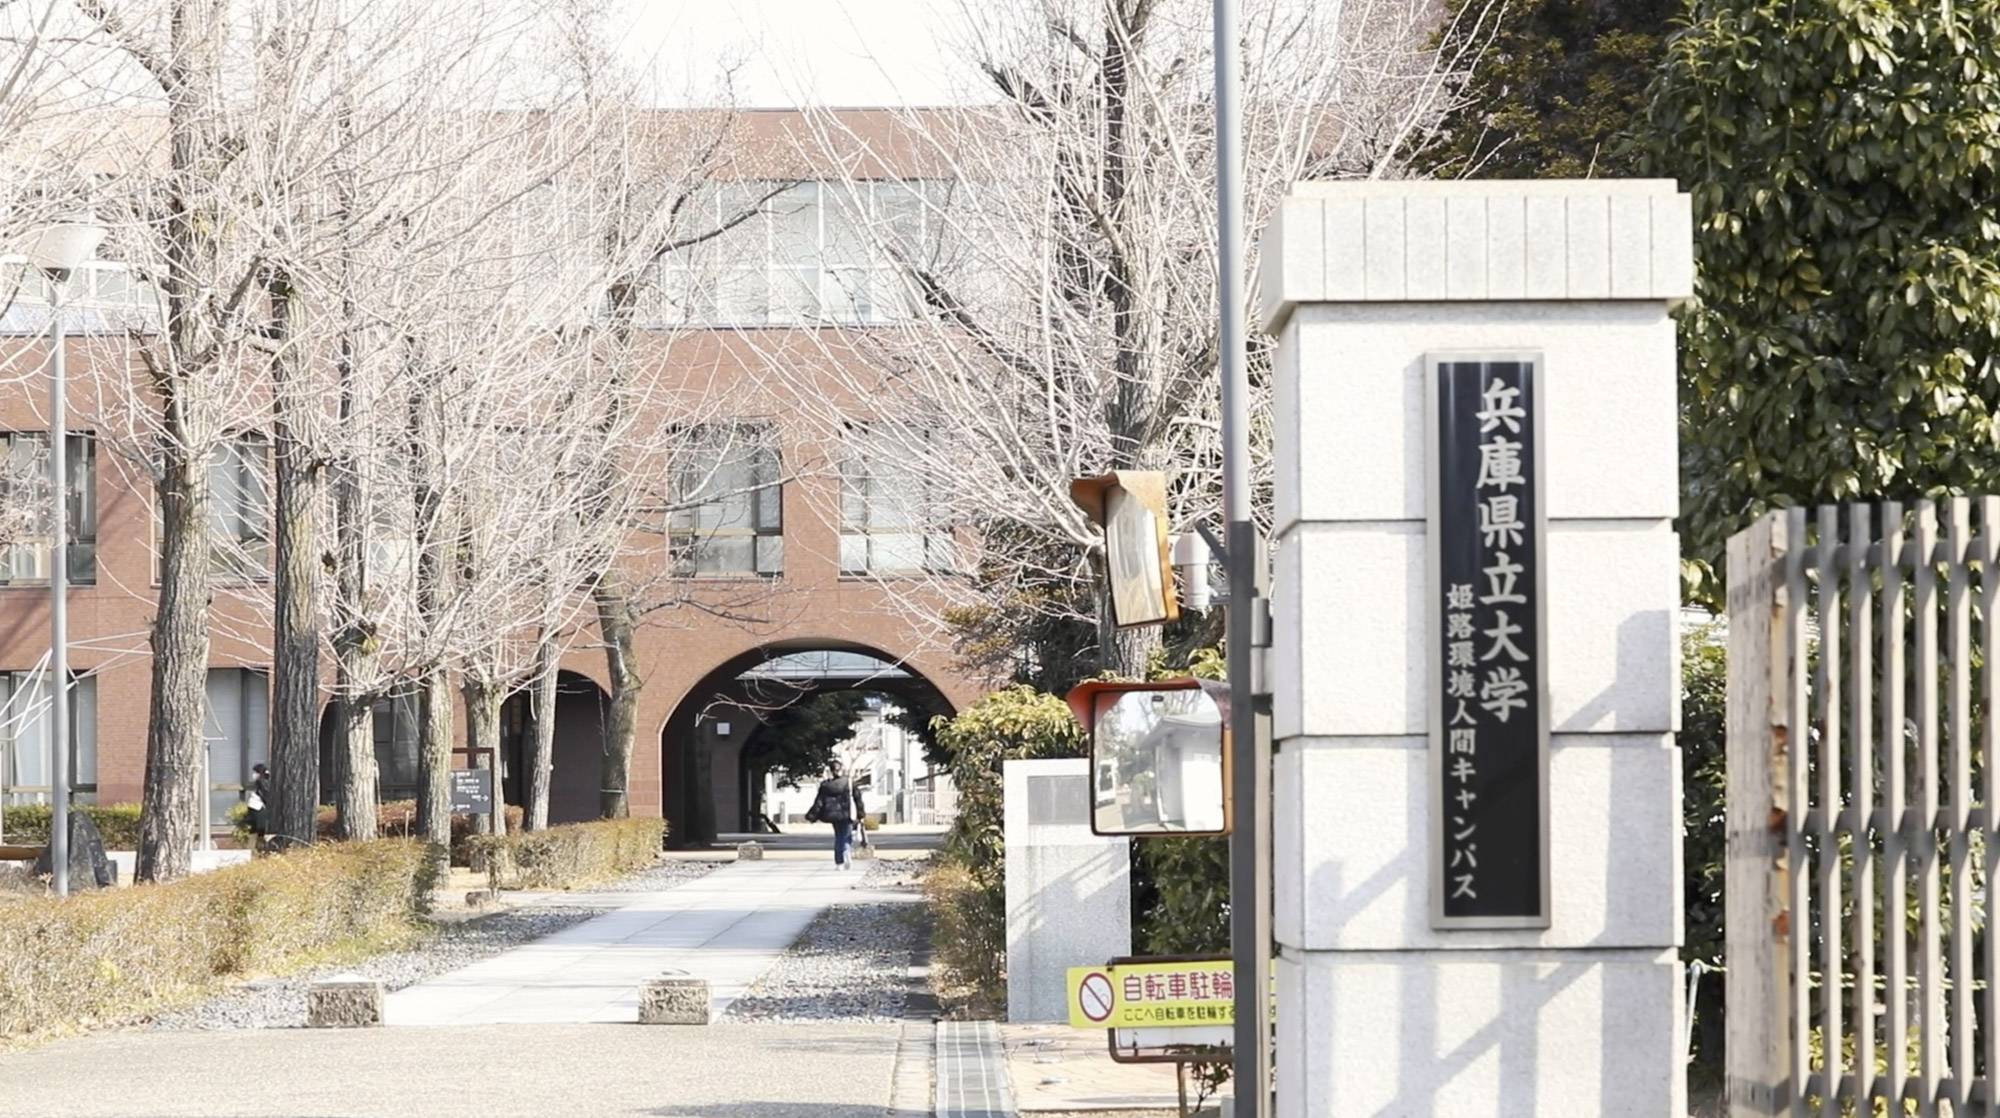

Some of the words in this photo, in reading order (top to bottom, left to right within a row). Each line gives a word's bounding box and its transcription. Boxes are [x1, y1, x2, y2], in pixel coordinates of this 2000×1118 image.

[1475, 378, 1529, 722] 兵庫県立大学
[1446, 583, 1477, 899] 姫路環境人間キャンパス
[1124, 972, 1233, 1001] 自転車駐輪
